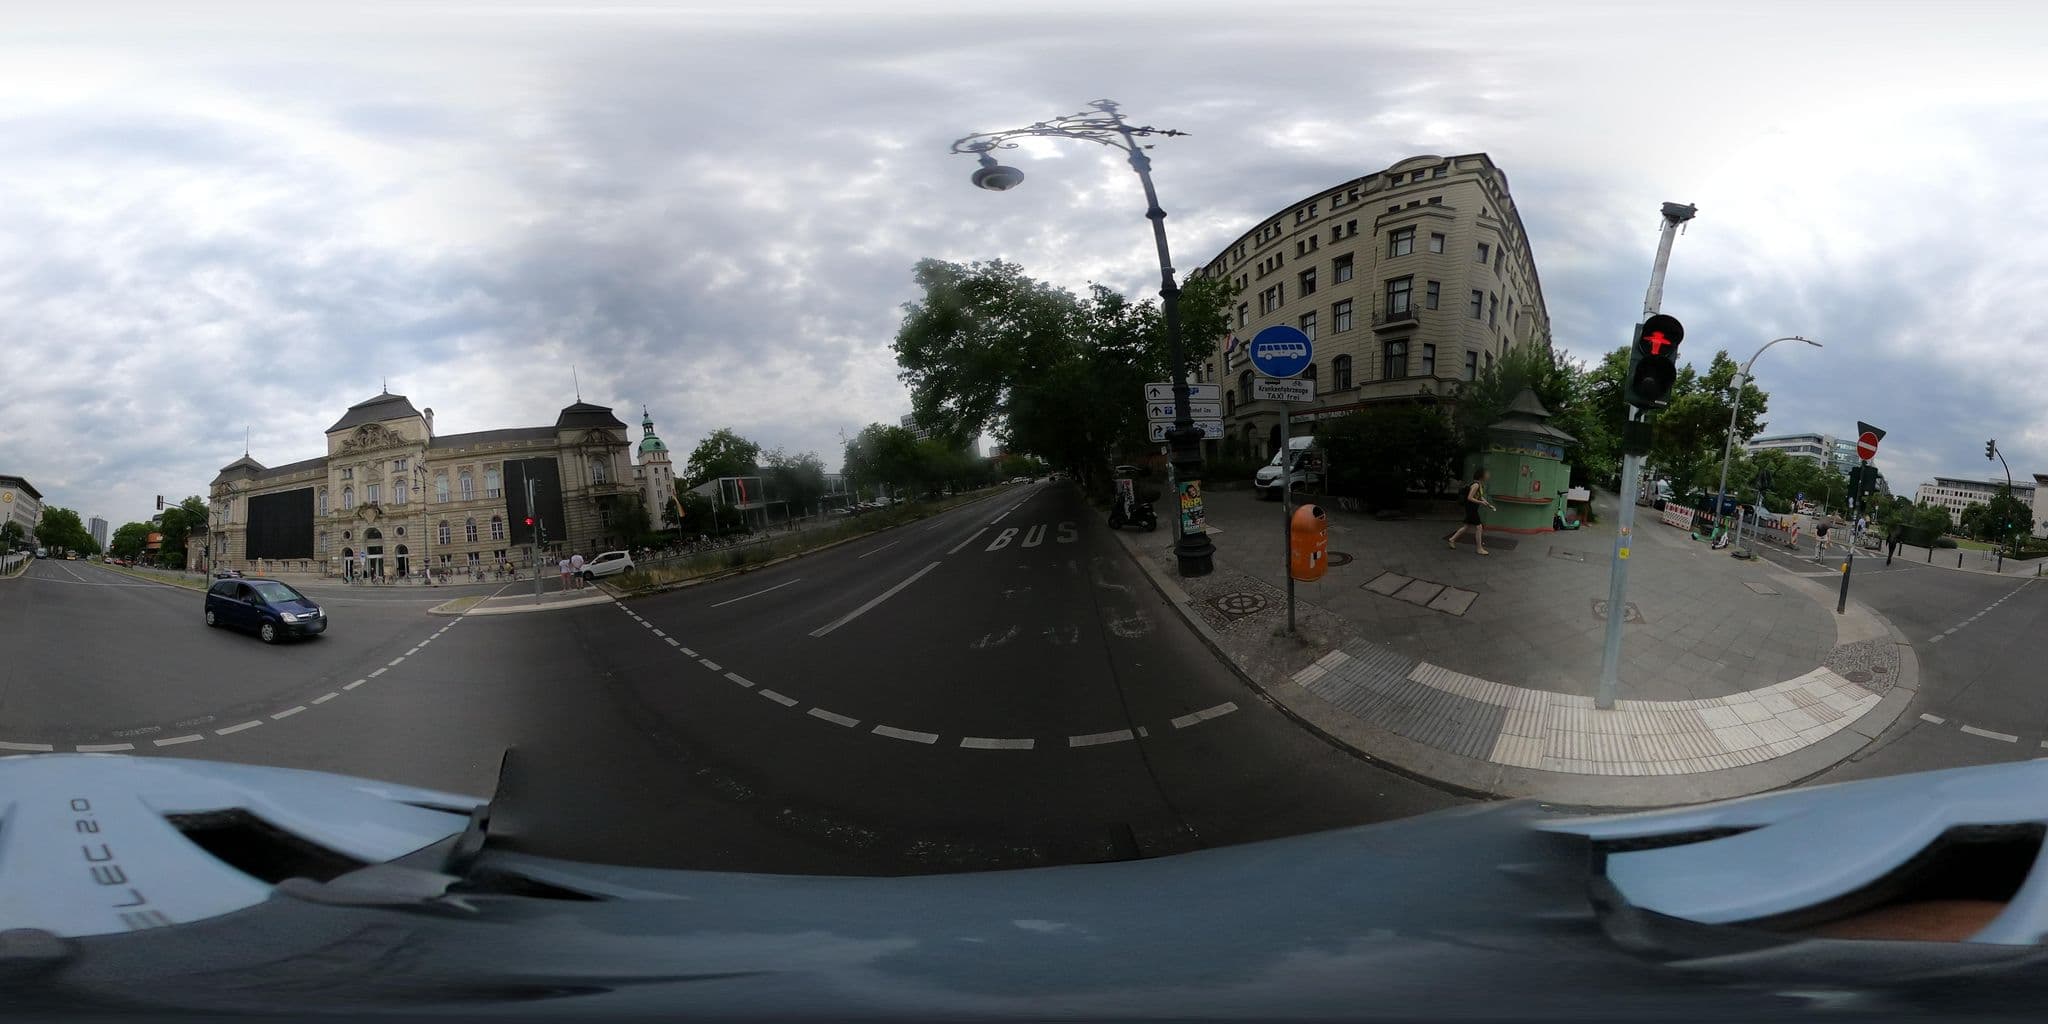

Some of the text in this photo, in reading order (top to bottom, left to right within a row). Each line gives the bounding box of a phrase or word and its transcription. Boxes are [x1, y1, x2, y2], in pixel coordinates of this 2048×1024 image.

[1267, 392, 1300, 401] TAXI frei
[984, 521, 1079, 552] BUS
[70, 797, 100, 833] 2.0
